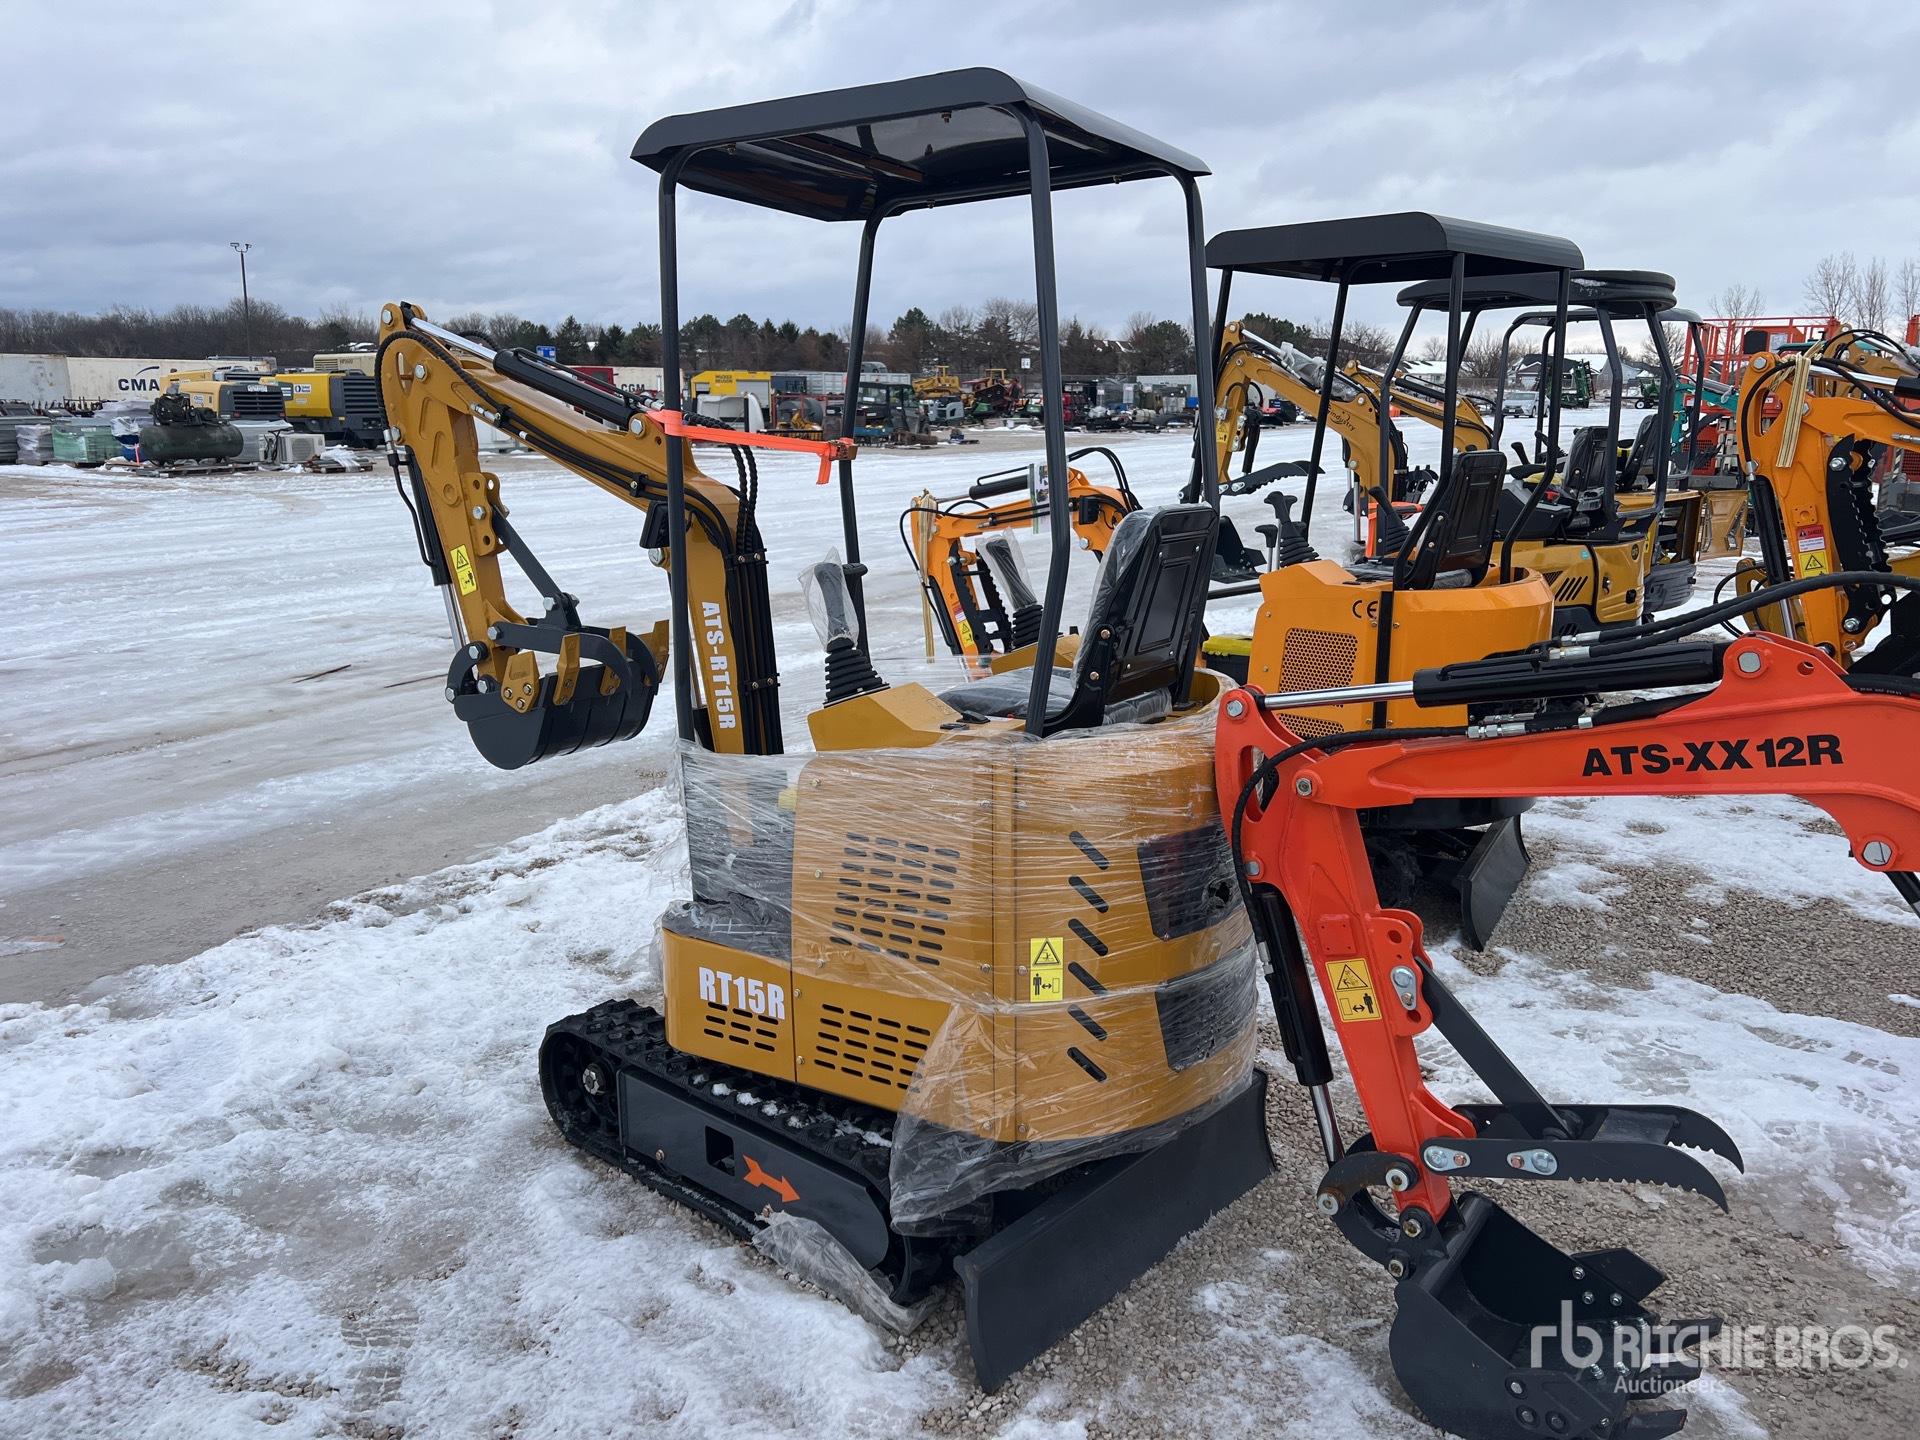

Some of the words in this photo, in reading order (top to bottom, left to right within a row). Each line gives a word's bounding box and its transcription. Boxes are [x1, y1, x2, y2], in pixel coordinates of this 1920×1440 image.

[118, 378, 160, 391] CMA
[621, 383, 645, 393] CGM
[702, 601, 736, 729] ATS-RT15R
[699, 966, 785, 1020] RT15R
